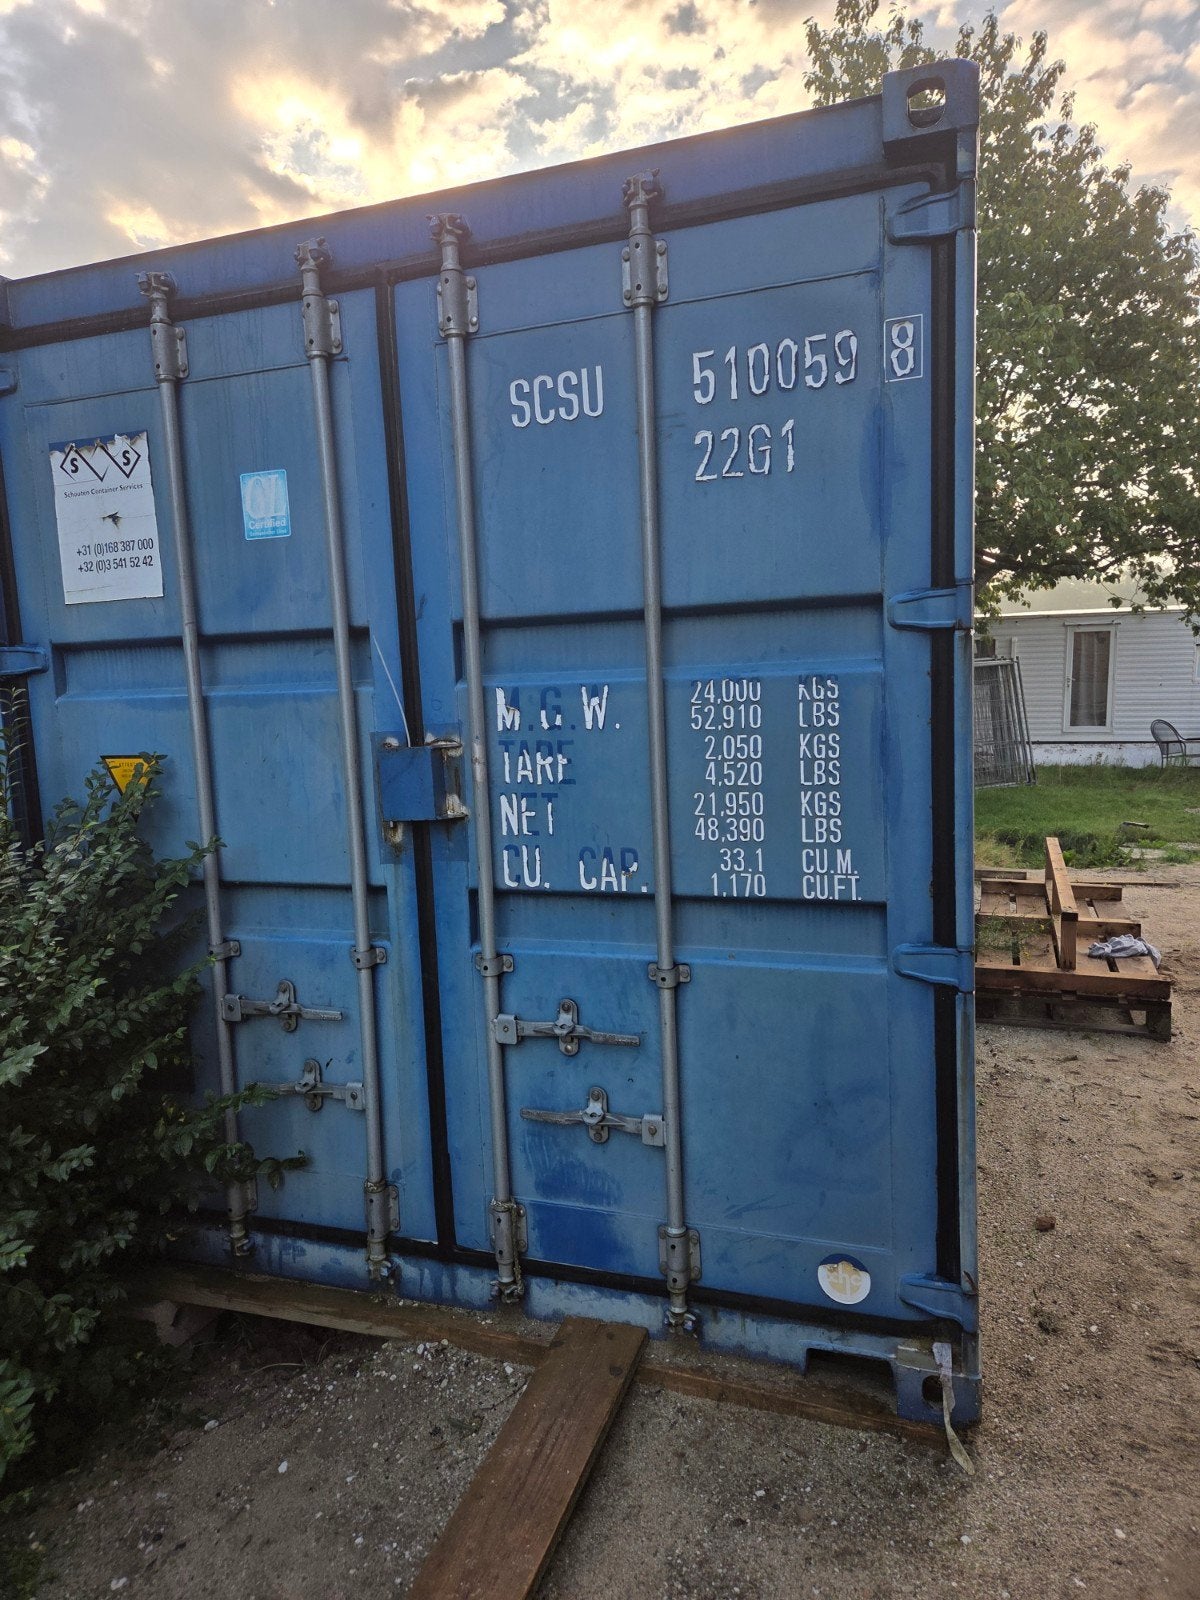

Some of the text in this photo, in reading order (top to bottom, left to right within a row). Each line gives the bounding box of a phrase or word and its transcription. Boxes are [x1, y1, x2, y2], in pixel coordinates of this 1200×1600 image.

[509, 321, 915, 428] SCSU 510059 8
[694, 418, 796, 481] 22G1
[64, 483, 143, 498] Schouten Container Services
[249, 518, 287, 529] Certified
[76, 537, 154, 557] +31 (0)168 387 000
[78, 555, 154, 574] +32 (0)3 541 52 42
[798, 674, 840, 700] KGS
[690, 701, 841, 731] 52,910 LBS
[498, 732, 841, 785] TARE 2,050 KGS
[705, 760, 841, 787] 4,520 LBS
[499, 790, 842, 836] NET 21,950 KGS
[694, 817, 842, 843] 48,390 LBS
[502, 844, 551, 889] CU.
[578, 845, 648, 892] CAP.
[719, 847, 763, 872] 33.1
[710, 872, 767, 899] 1,170
